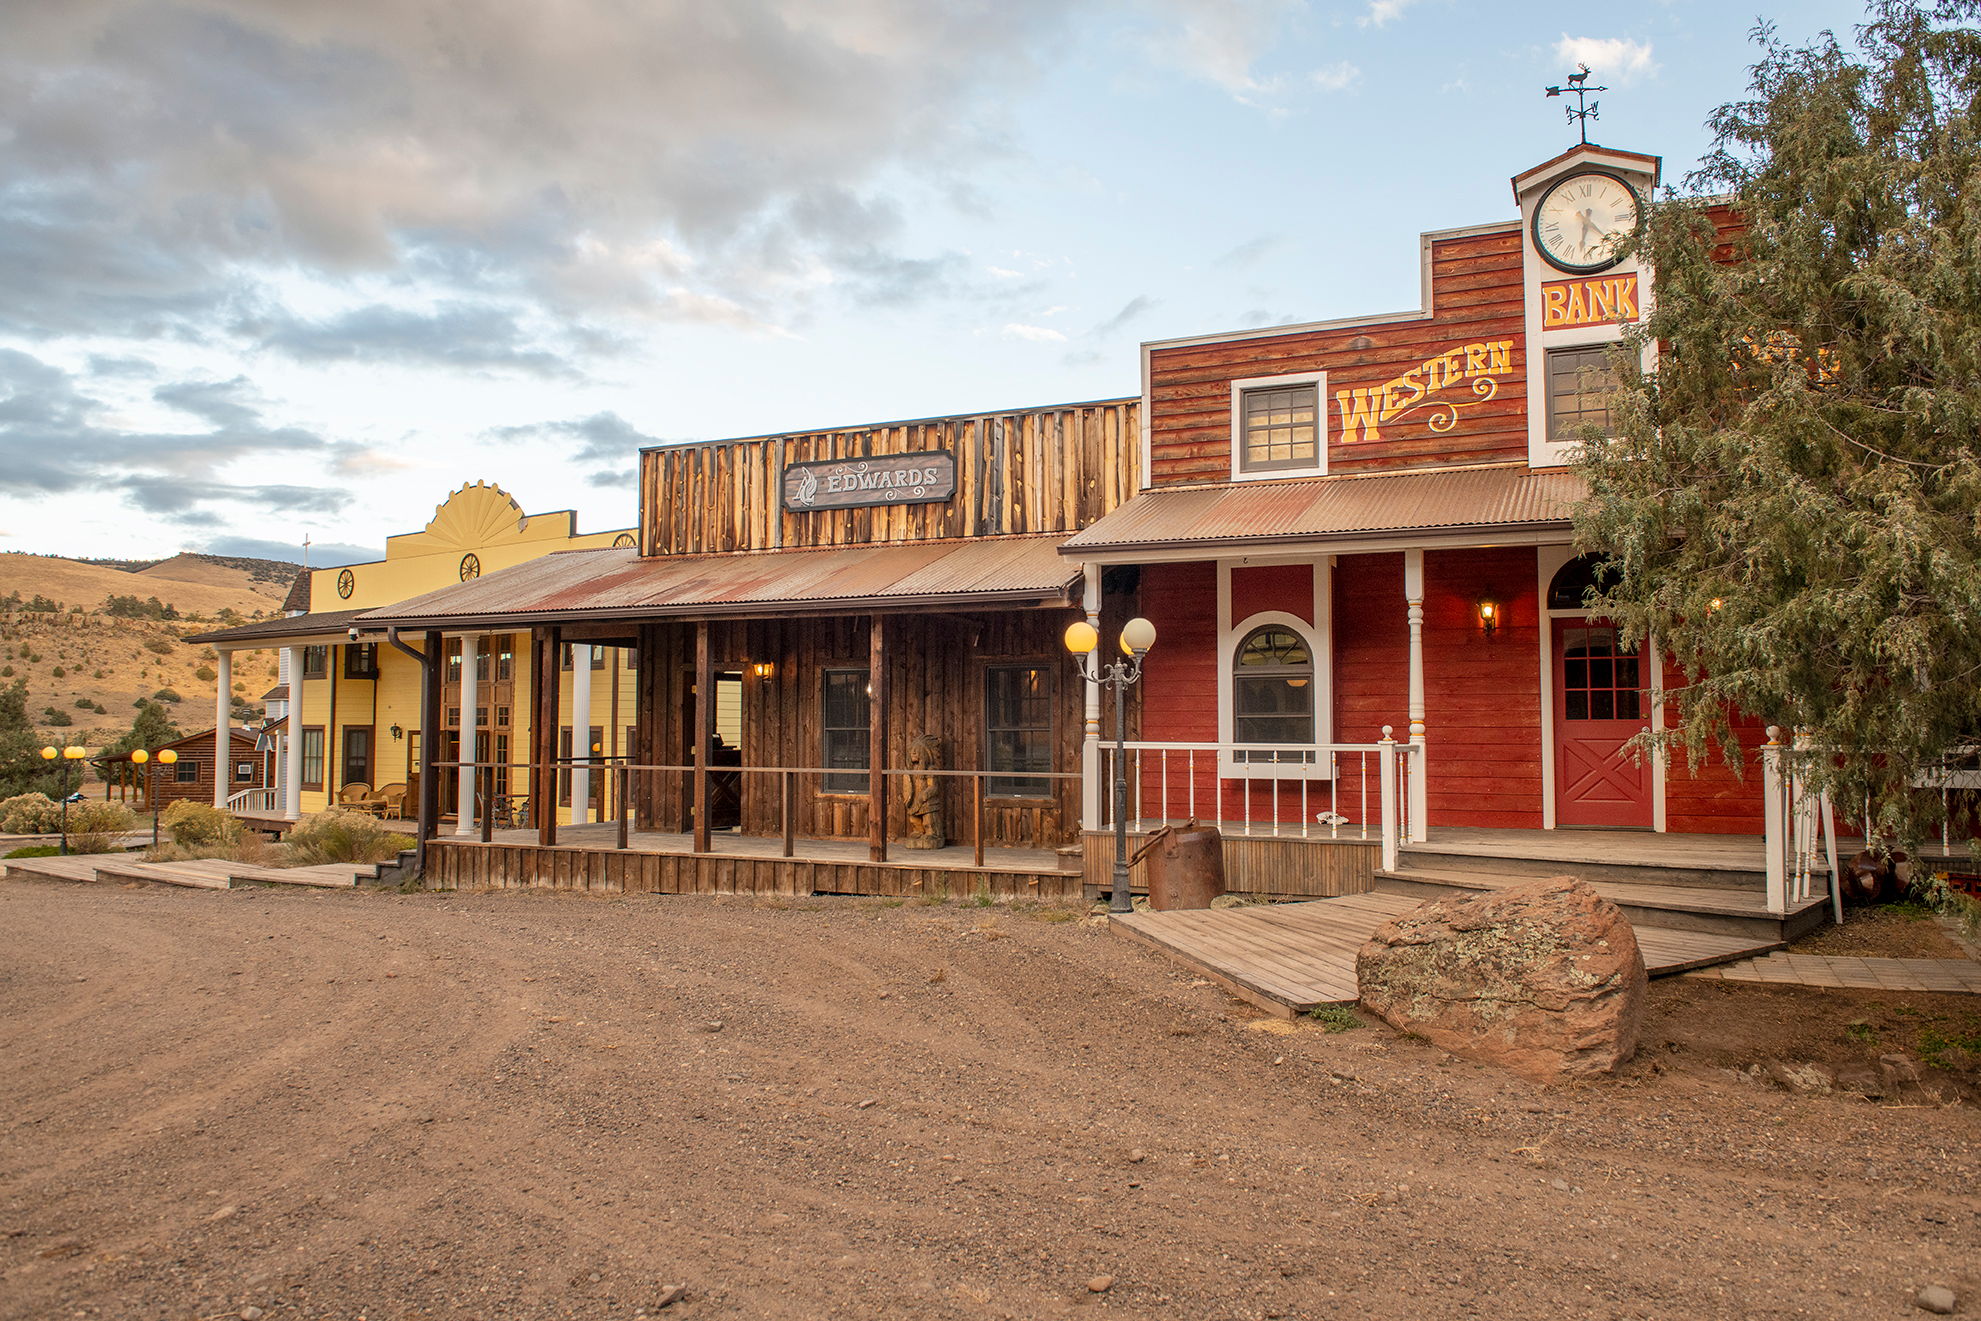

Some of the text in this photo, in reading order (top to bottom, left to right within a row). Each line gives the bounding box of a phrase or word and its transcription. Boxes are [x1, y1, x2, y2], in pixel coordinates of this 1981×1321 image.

[1560, 189, 1576, 205] XI
[1579, 184, 1592, 198] XII
[1548, 205, 1564, 216] X
[1609, 197, 1624, 209] II
[1544, 221, 1560, 232] IX
[1548, 233, 1564, 251] VIII
[1561, 243, 1576, 260] VII
[1542, 276, 1639, 327] BANK
[1336, 340, 1514, 444] WESTERN
[827, 467, 938, 494] EDWARDS
